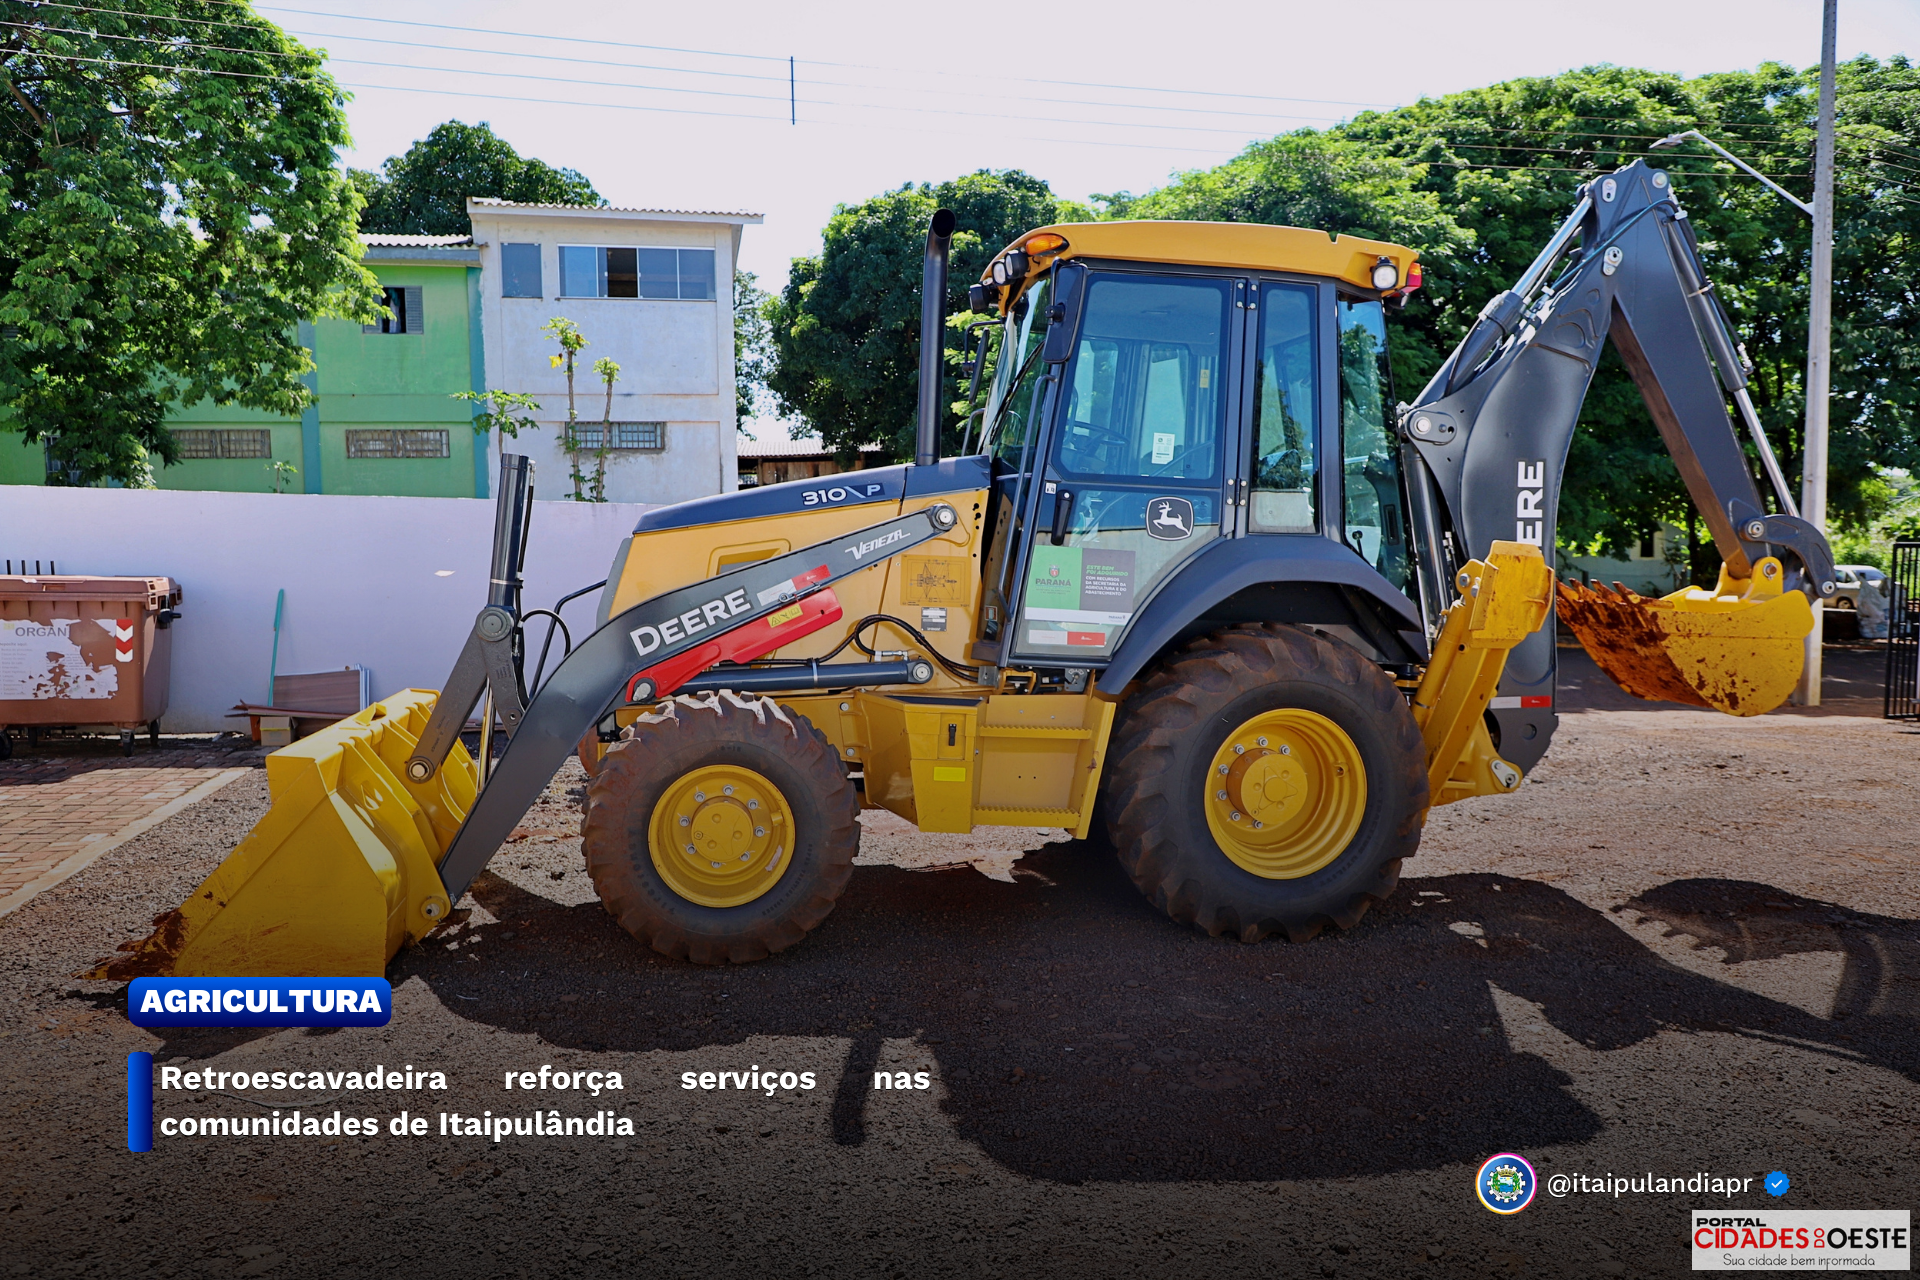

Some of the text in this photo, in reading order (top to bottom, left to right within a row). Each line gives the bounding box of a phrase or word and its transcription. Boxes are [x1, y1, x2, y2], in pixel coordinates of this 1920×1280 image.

[803, 484, 881, 506] 310 P
[1516, 461, 1544, 554] ERE
[1035, 578, 1072, 586] PARANÁ
[629, 588, 752, 657] DEERE
